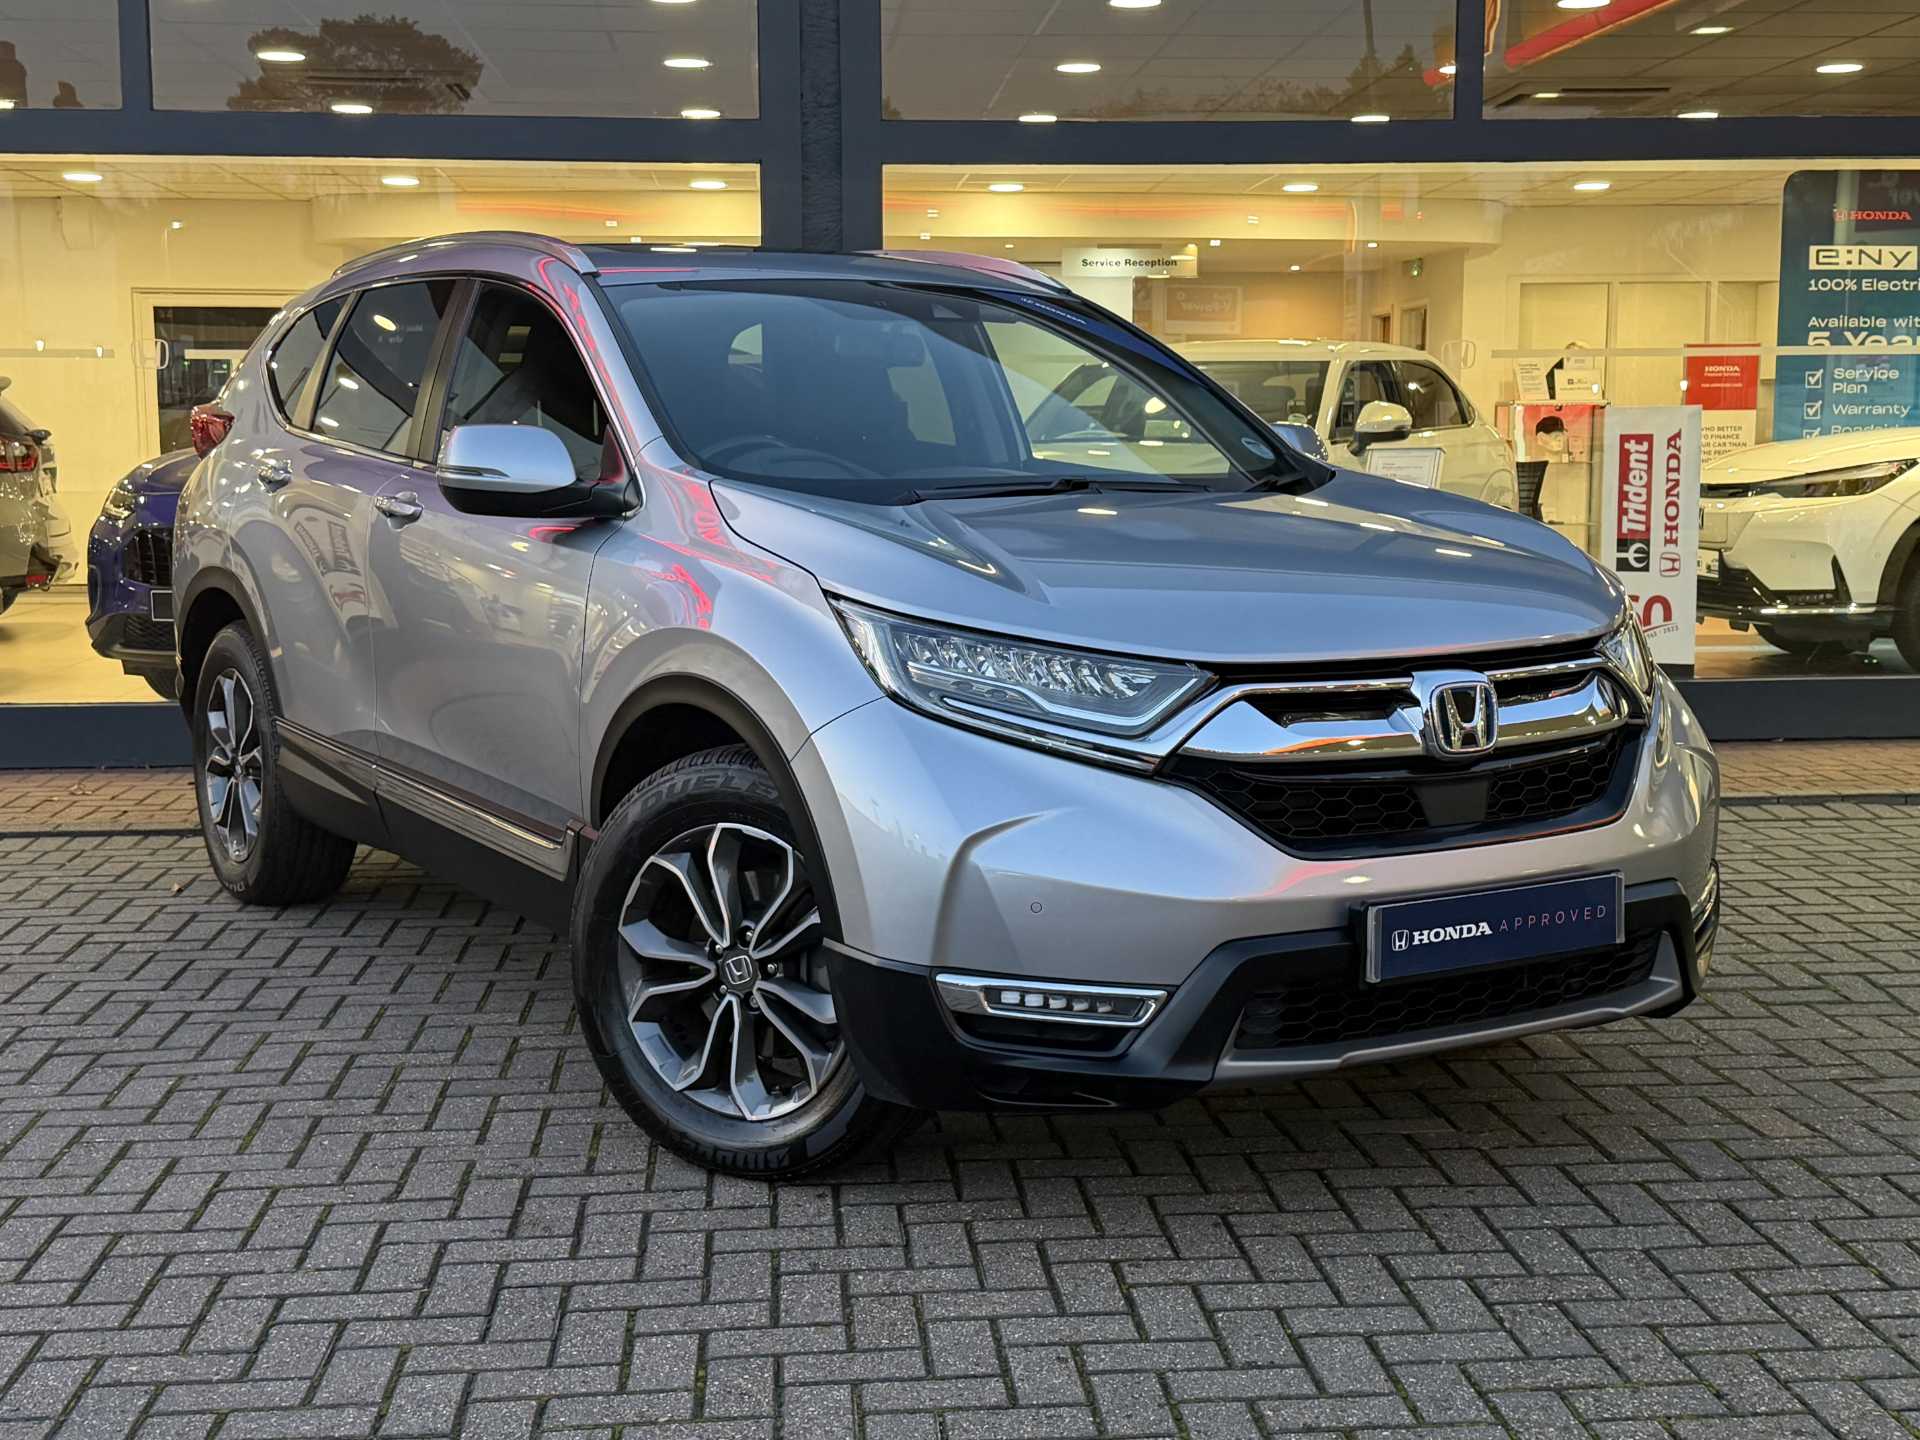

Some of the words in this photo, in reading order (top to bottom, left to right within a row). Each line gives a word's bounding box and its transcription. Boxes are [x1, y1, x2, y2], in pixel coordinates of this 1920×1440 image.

[1850, 210, 1912, 221] HONDA
[1081, 258, 1121, 267] Service
[1124, 258, 1178, 268] Reception
[1808, 278, 1857, 291] 100%
[1808, 315, 1887, 328] Available
[1833, 366, 1900, 380] Service
[1832, 382, 1868, 394] Plan
[1832, 403, 1911, 418] Warranty
[1621, 440, 1649, 534] Trident
[1664, 427, 1682, 547] HONDA
[1412, 921, 1493, 946] HONDA
[1500, 905, 1607, 932] APPROVED
